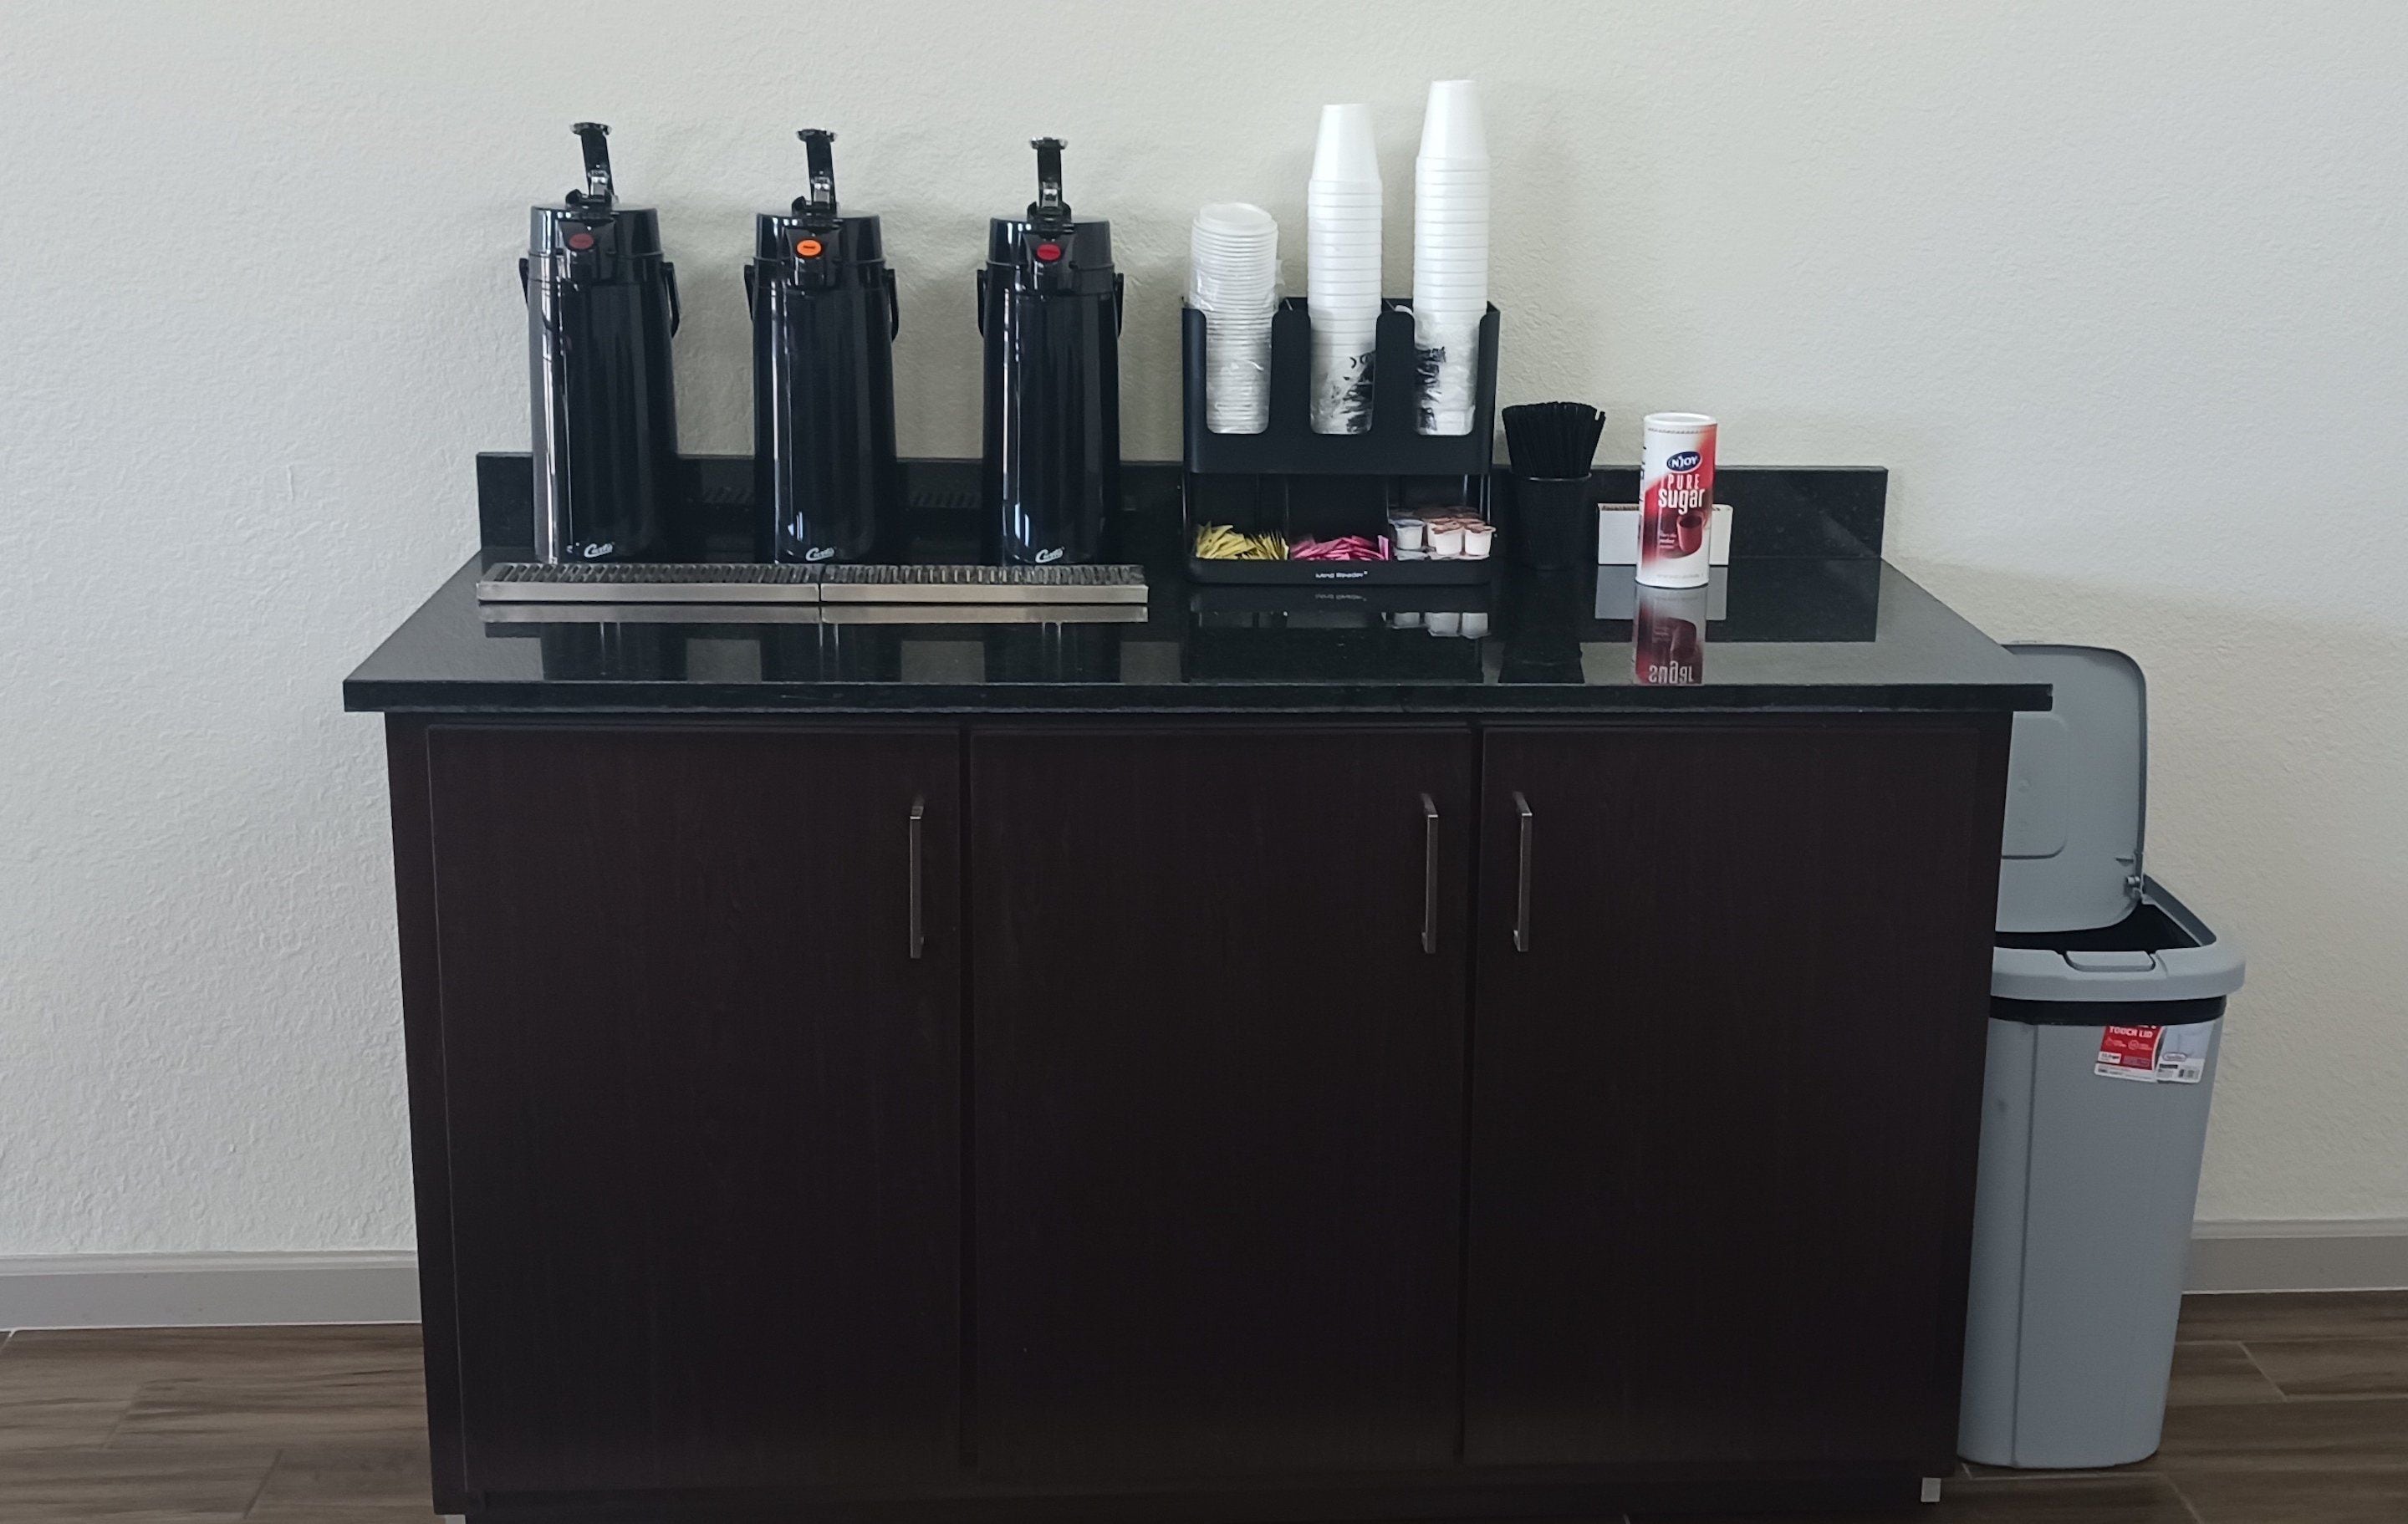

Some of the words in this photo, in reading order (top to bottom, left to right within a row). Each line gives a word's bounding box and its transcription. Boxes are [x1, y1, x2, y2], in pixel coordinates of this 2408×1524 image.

[1667, 474, 1701, 490] PURE
[1658, 488, 1705, 515] sugar
[2109, 1026, 2138, 1037] TOUCH
